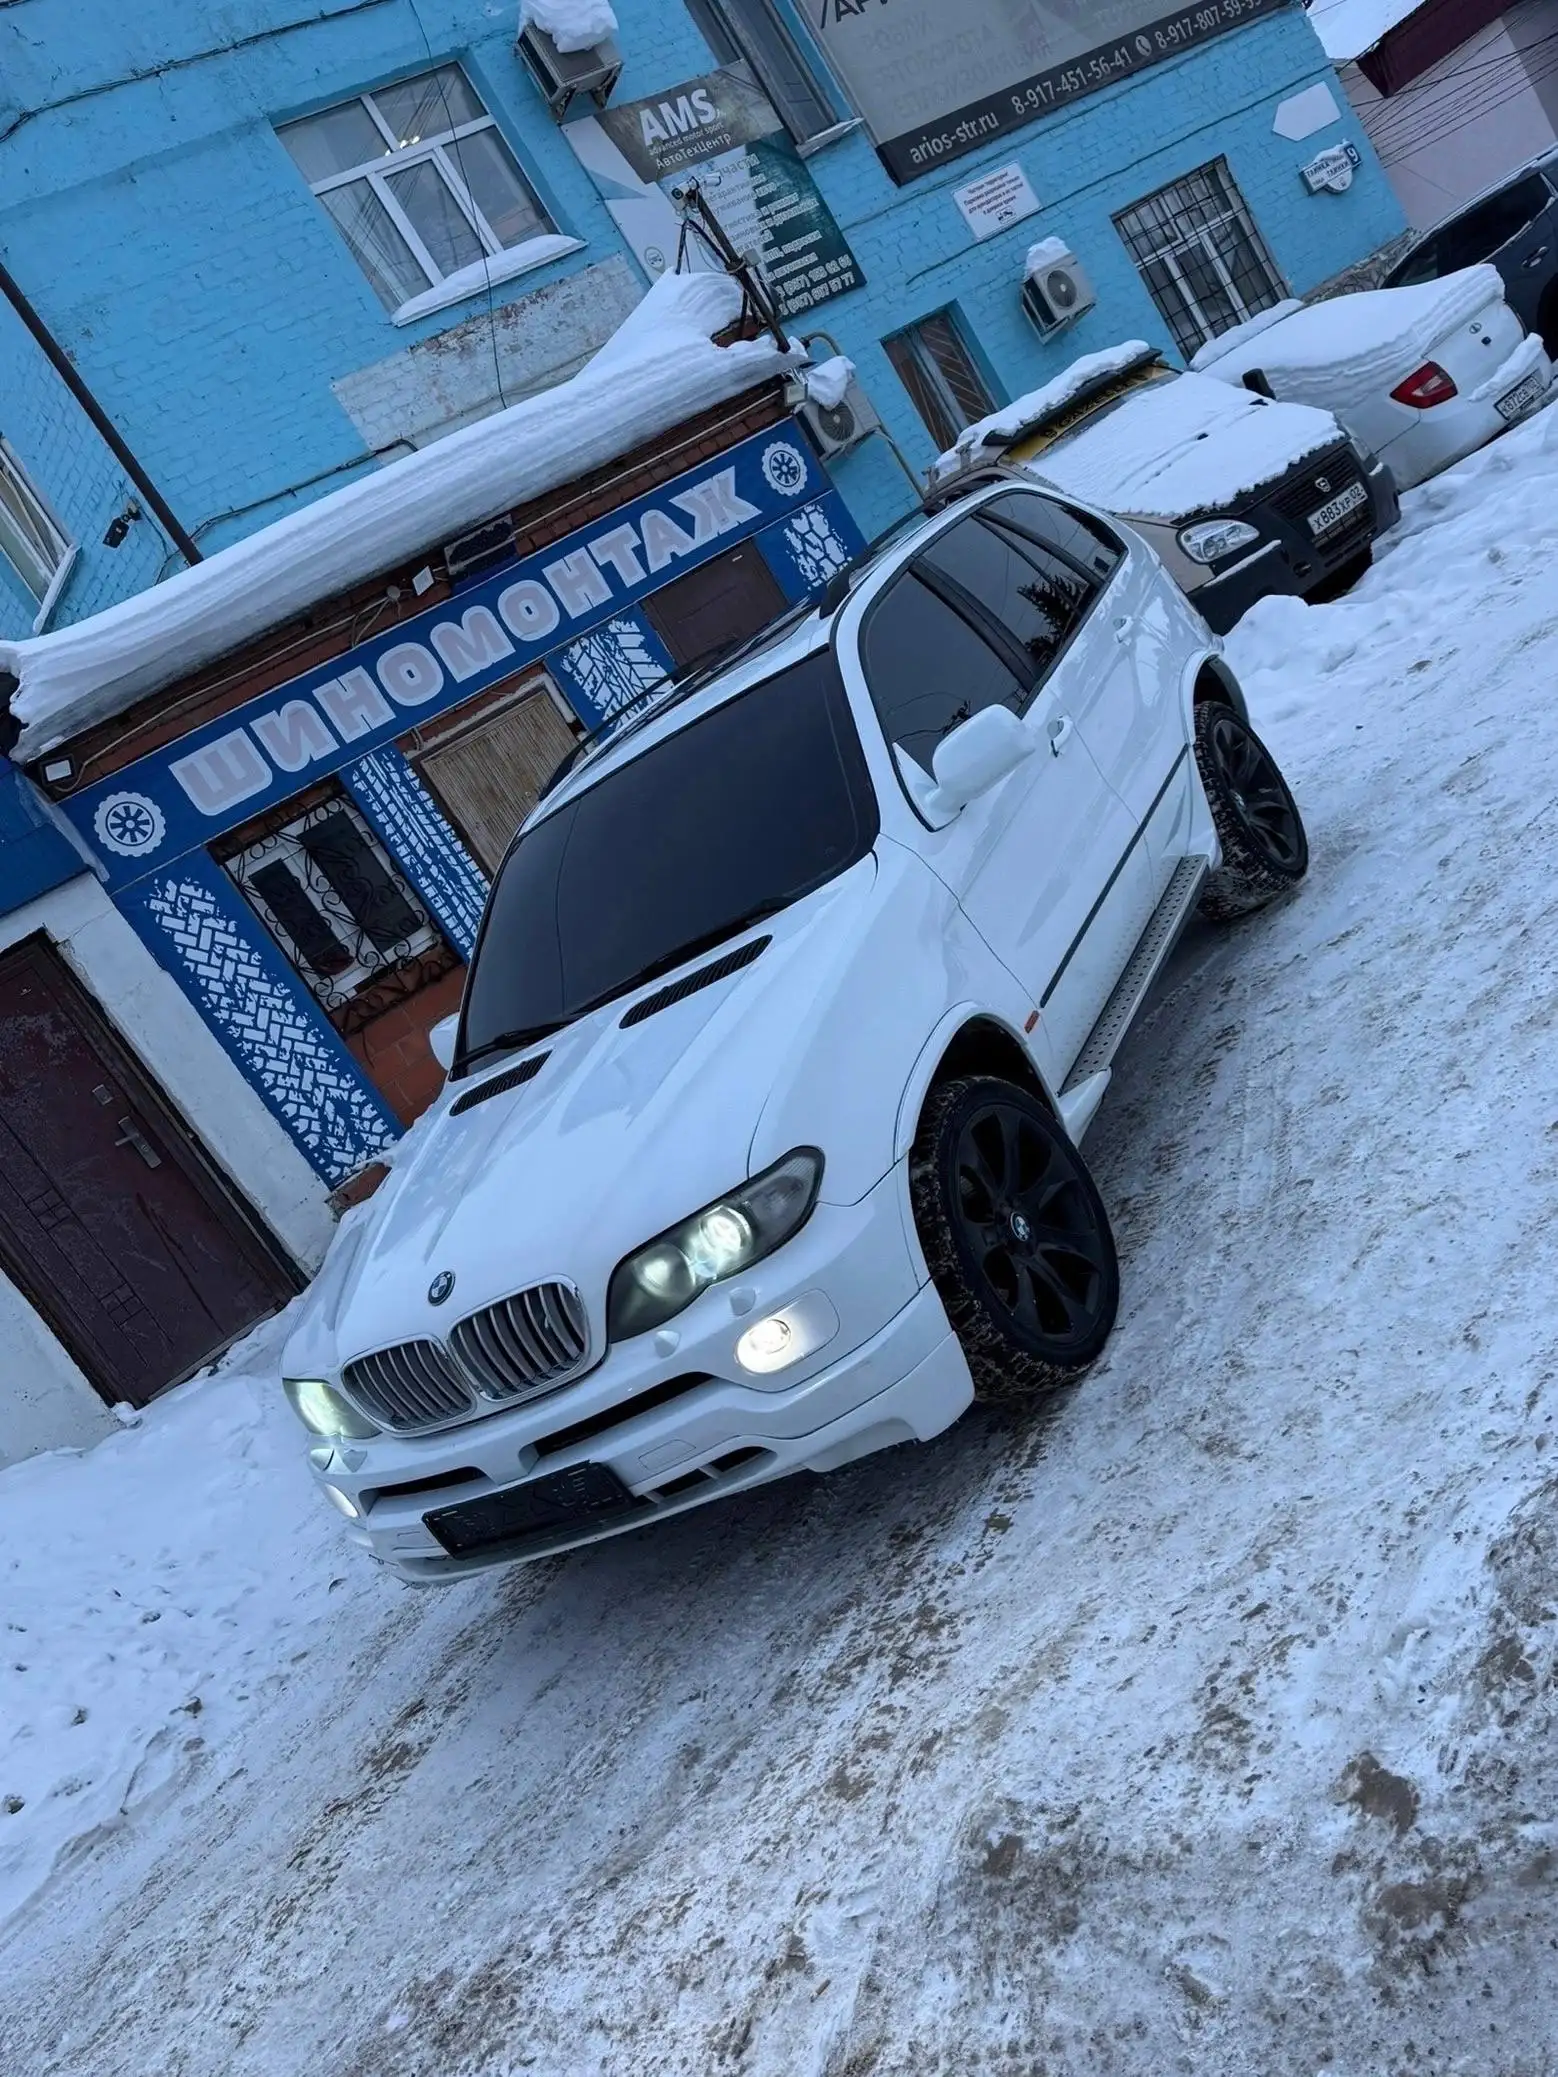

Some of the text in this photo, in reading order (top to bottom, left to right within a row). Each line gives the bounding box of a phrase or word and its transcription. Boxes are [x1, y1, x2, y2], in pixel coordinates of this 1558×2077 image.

[640, 88, 717, 146] AMS
[910, 112, 999, 164] arios-str.ru
[1011, 46, 1133, 115] 8-917-451-56-41
[649, 137, 681, 156] advanced
[656, 133, 732, 169] АвтоТехЦентр
[1346, 147, 1359, 162] 9
[168, 466, 763, 816] ШИНОМОНТАЖ
